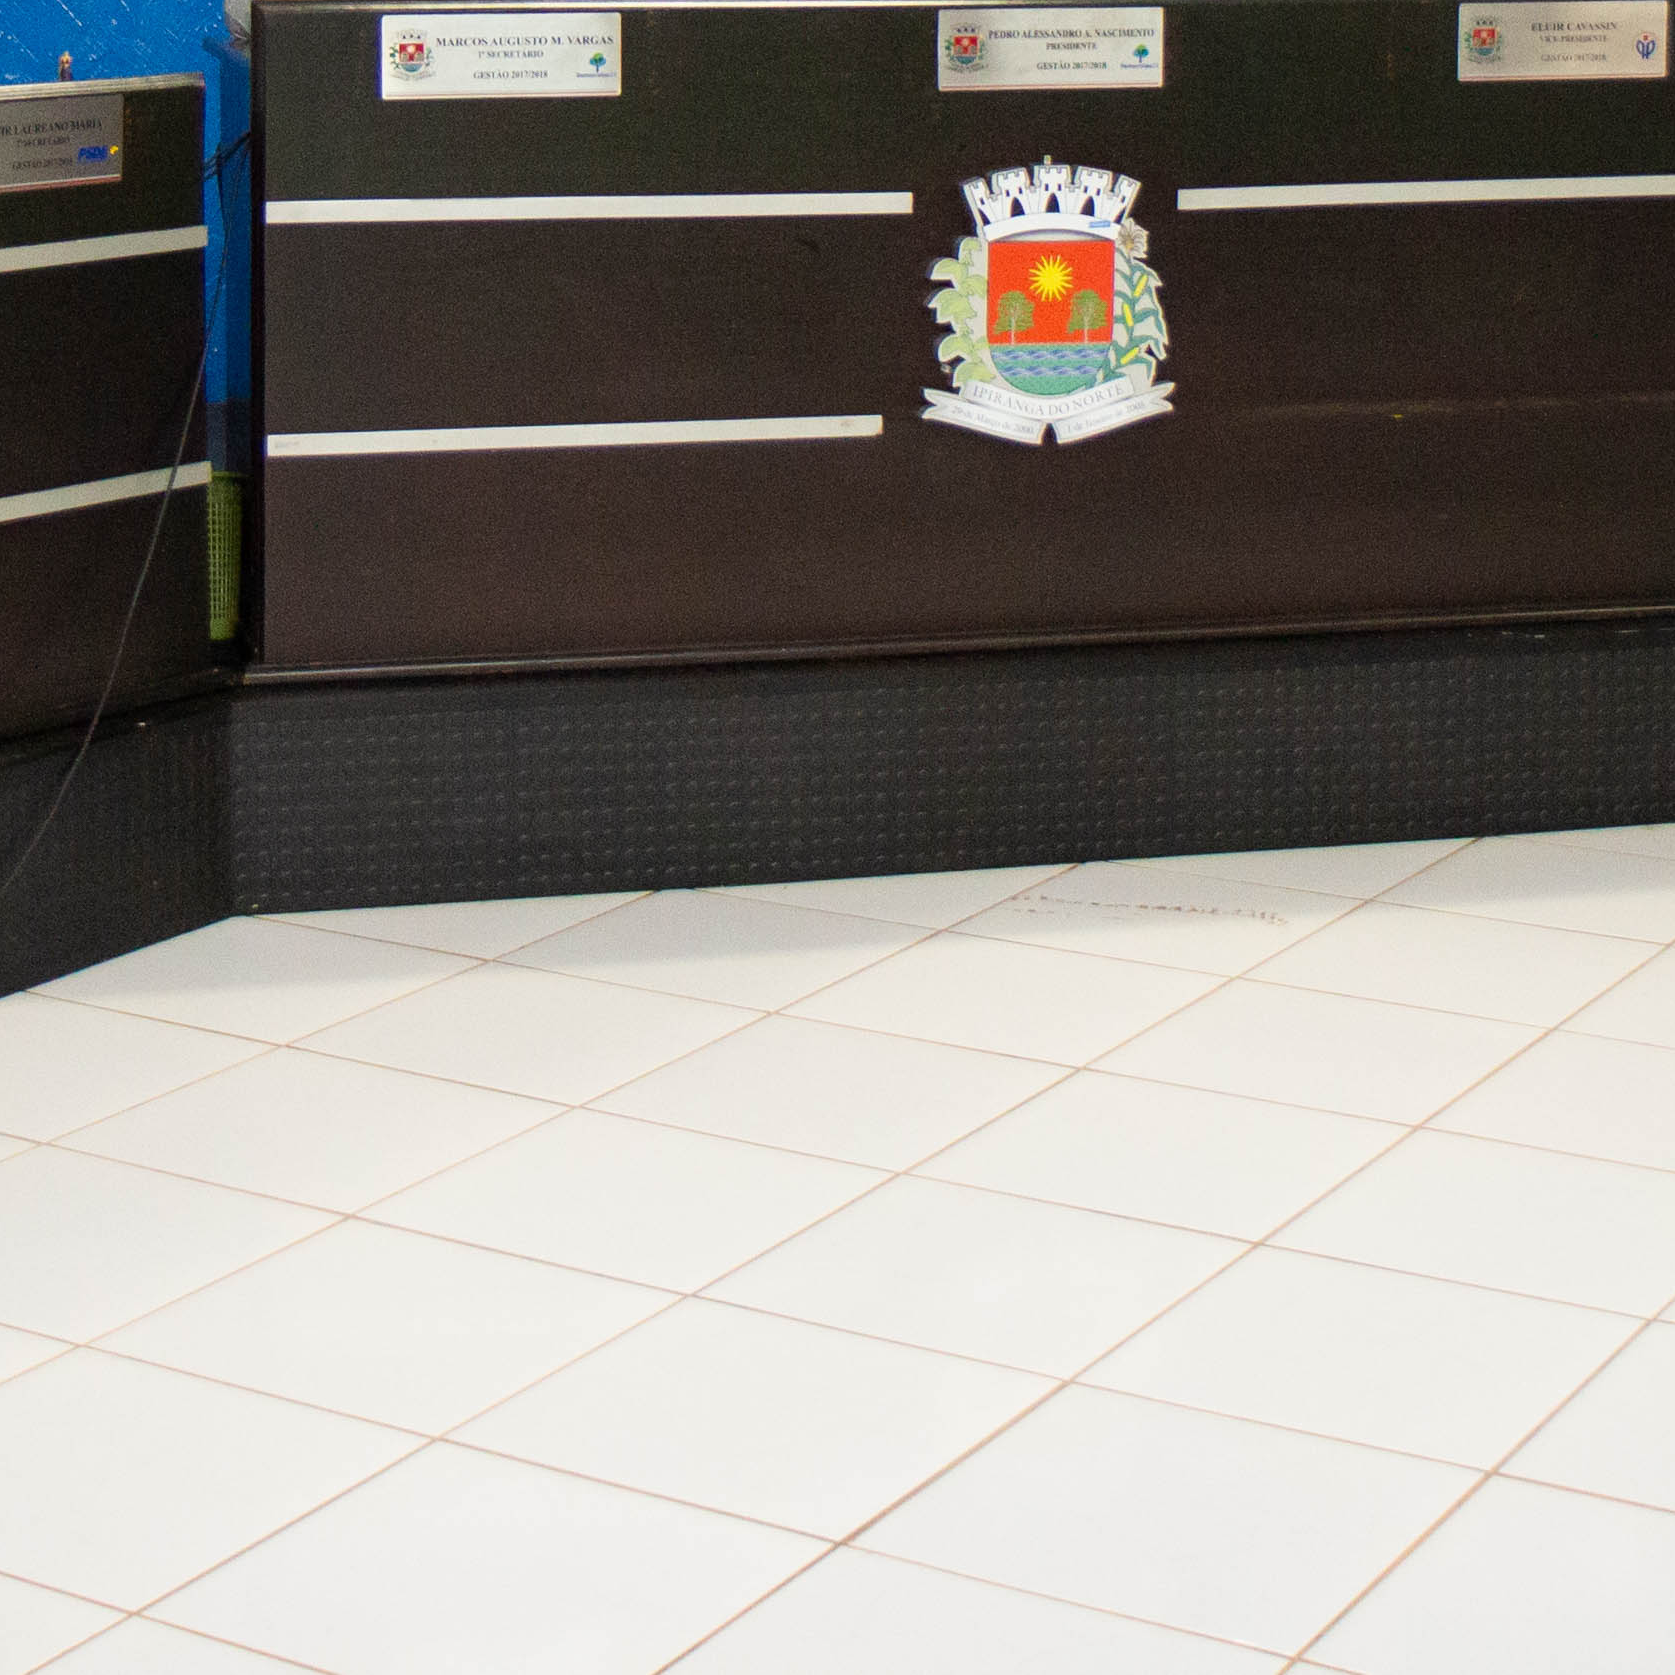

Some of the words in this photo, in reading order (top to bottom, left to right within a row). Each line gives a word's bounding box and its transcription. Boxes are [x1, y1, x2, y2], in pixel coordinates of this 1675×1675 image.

[988, 29, 1020, 40] PEDRO
[1022, 28, 1083, 39] ALESSANDRO
[1094, 28, 1155, 38] NASCIMENTO
[436, 36, 489, 47] MARCOS
[491, 36, 548, 47] AUGUSTO
[567, 35, 615, 45] VARGAS
[1046, 41, 1098, 51] PRESIDENTE
[973, 385, 1044, 416] IPIRANGA
[1047, 404, 1070, 416] DO
[1071, 383, 1124, 412] NORTE
